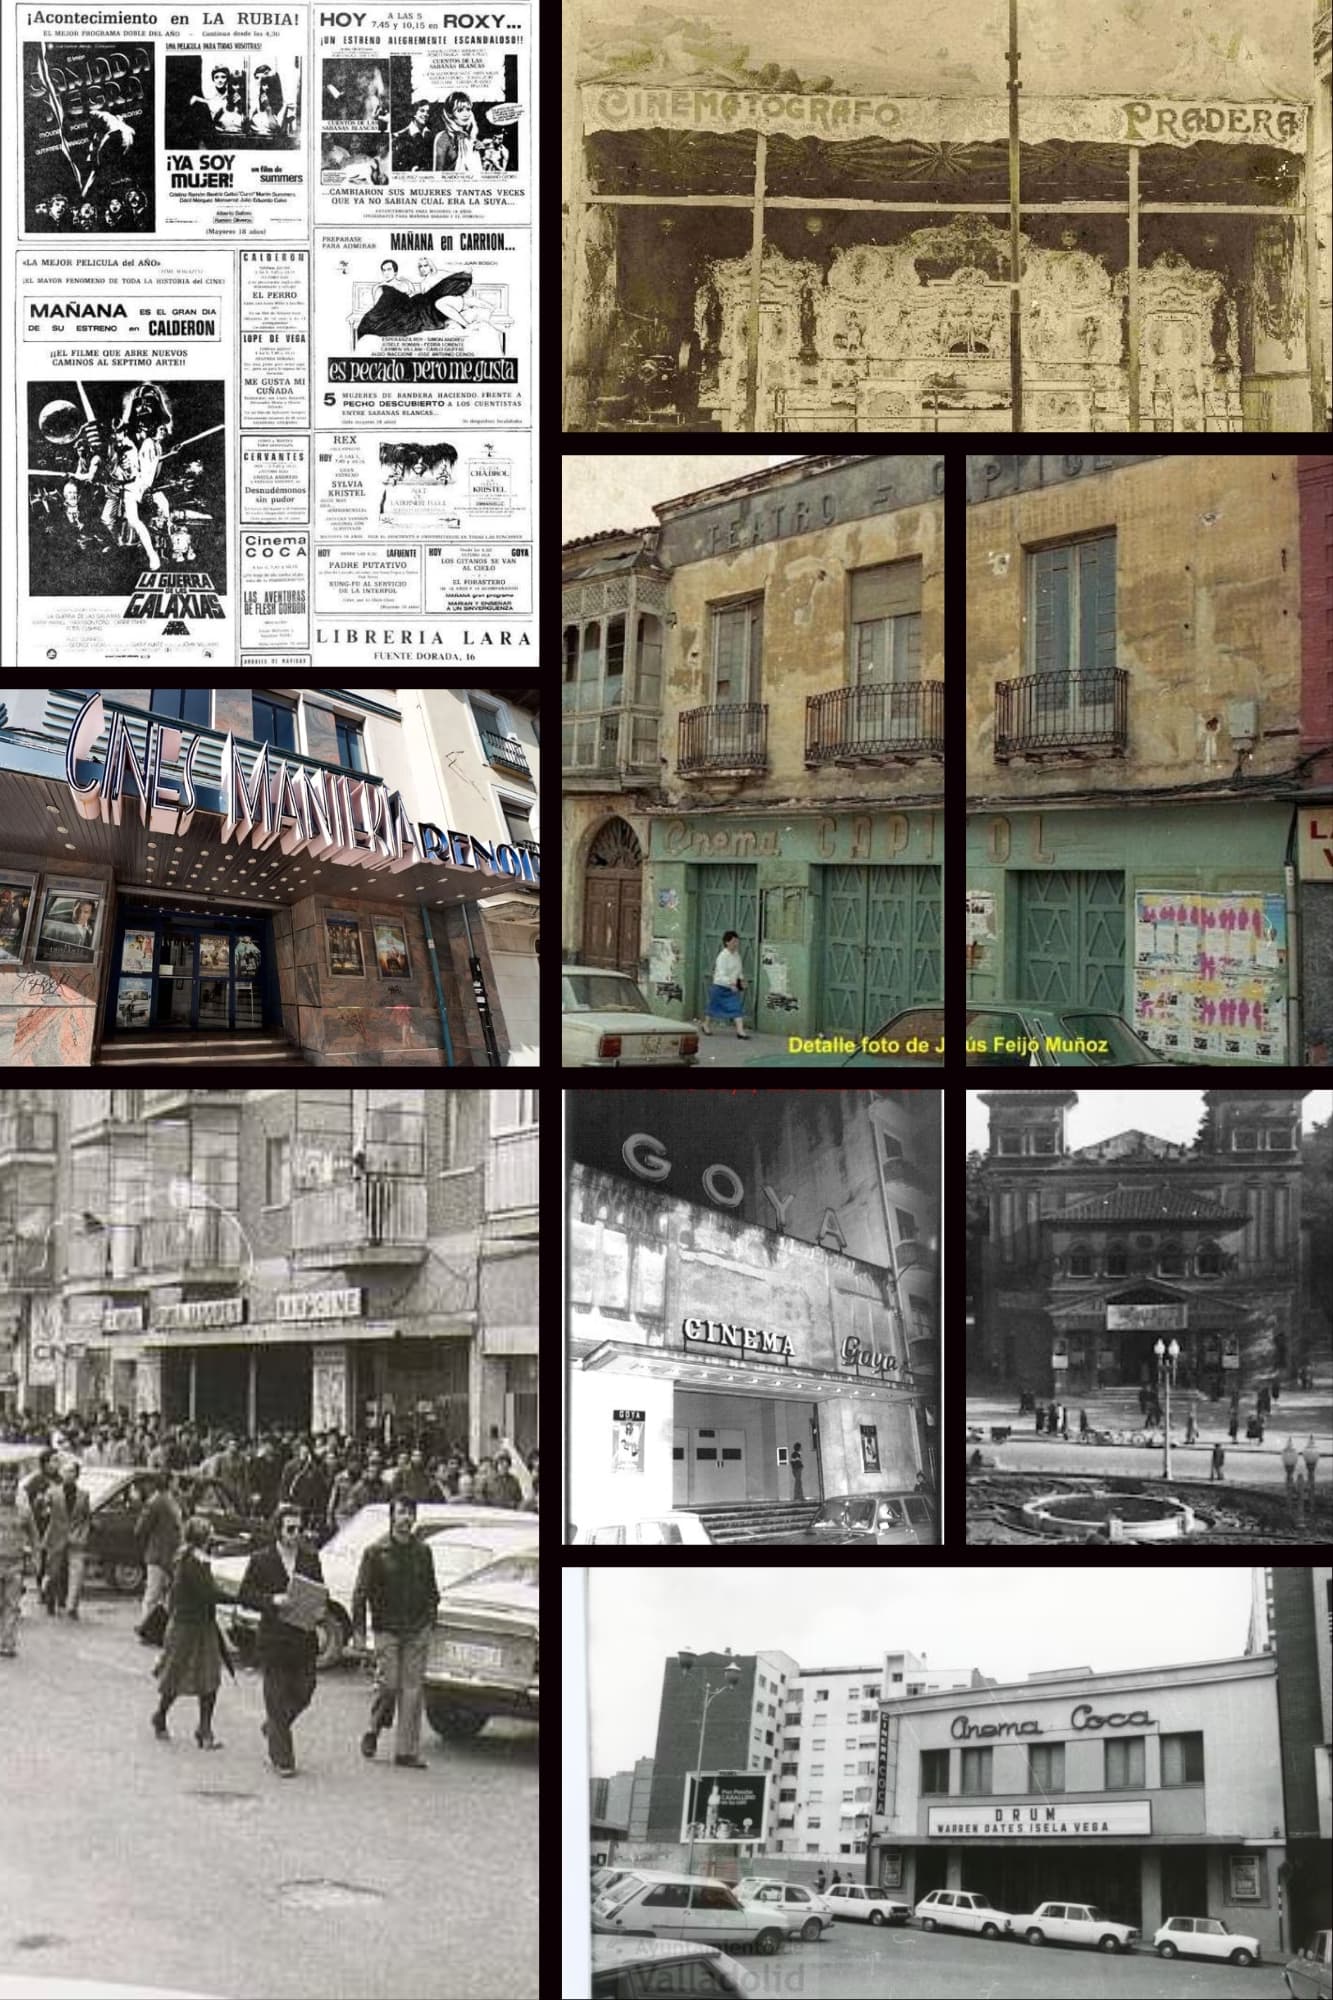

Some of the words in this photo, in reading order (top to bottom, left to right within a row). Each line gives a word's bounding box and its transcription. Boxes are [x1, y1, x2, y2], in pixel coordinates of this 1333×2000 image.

[27, 10, 158, 26] ¡Acontecimiento
[170, 14, 189, 25] en
[202, 12, 224, 25] LA
[237, 12, 299, 26] RUBIA!
[320, 12, 367, 27] HOY
[443, 14, 522, 29] ROXY...
[388, 12, 394, 20] A
[397, 12, 413, 20] LAS
[599, 89, 900, 129] CINEMATOGRAFO
[1120, 101, 1300, 142] PRADERA
[167, 154, 193, 171] ¡YA
[199, 154, 235, 171] SOY
[259, 174, 303, 183] summers
[331, 197, 350, 205] QUE
[354, 197, 365, 205] YA
[368, 197, 382, 205] NO
[421, 197, 444, 205] CUAL
[447, 197, 465, 205] ERA
[469, 197, 480, 205] LA
[390, 231, 434, 251] MAÑANA
[441, 235, 453, 251] en
[460, 233, 515, 251] CARRION...
[243, 253, 305, 262] CALDERON
[30, 301, 128, 318] MAÑANA
[149, 320, 215, 336] CALDERON
[243, 334, 263, 343] LOPE
[269, 334, 279, 343] DE
[285, 334, 306, 343] VEGA
[71, 350, 100, 358] FILME
[102, 350, 121, 358] QUE
[124, 350, 149, 358] ABRE
[152, 350, 188, 358] NUEVOS
[244, 378, 258, 386] ME
[261, 378, 291, 386] GUSTA
[294, 378, 306, 386] MI
[256, 386, 294, 395] CUÑADA
[323, 393, 336, 407] 5
[343, 400, 376, 408] PECHO
[379, 400, 445, 408] DESCUBIERTO
[333, 435, 357, 444] REX
[243, 452, 304, 461] CERVANTES
[271, 496, 295, 504] pudor
[245, 535, 306, 546] Cinema
[245, 547, 307, 558] COCA
[386, 549, 416, 558] LAFUENTE
[511, 548, 529, 557] GOYA
[329, 561, 359, 569] PADRE
[362, 561, 407, 569] PUTATIVO
[138, 574, 155, 588] LA
[158, 574, 212, 588] GUERRA
[244, 590, 257, 603] LAS
[123, 593, 226, 619] GALAXIAS
[316, 629, 444, 645] LIBRERIA
[463, 629, 531, 645] LARA
[374, 651, 414, 661] FUENTE
[416, 651, 462, 663] DORADA,
[466, 651, 476, 661] 16
[66, 691, 200, 832] CINES
[665, 817, 782, 857] Cinema
[622, 1132, 848, 1253] GOYA
[683, 1317, 797, 1358] CINEMA
[841, 1335, 899, 1375] Goya
[951, 1715, 1044, 1740] Cinema
[1071, 1703, 1156, 1731] Coca
[995, 1806, 1056, 1822] DRUM
[937, 1823, 979, 1833] WARREN
[984, 1823, 1024, 1833] OATES
[1030, 1822, 1067, 1833] ISELA
[1073, 1821, 1109, 1832] VEGA
